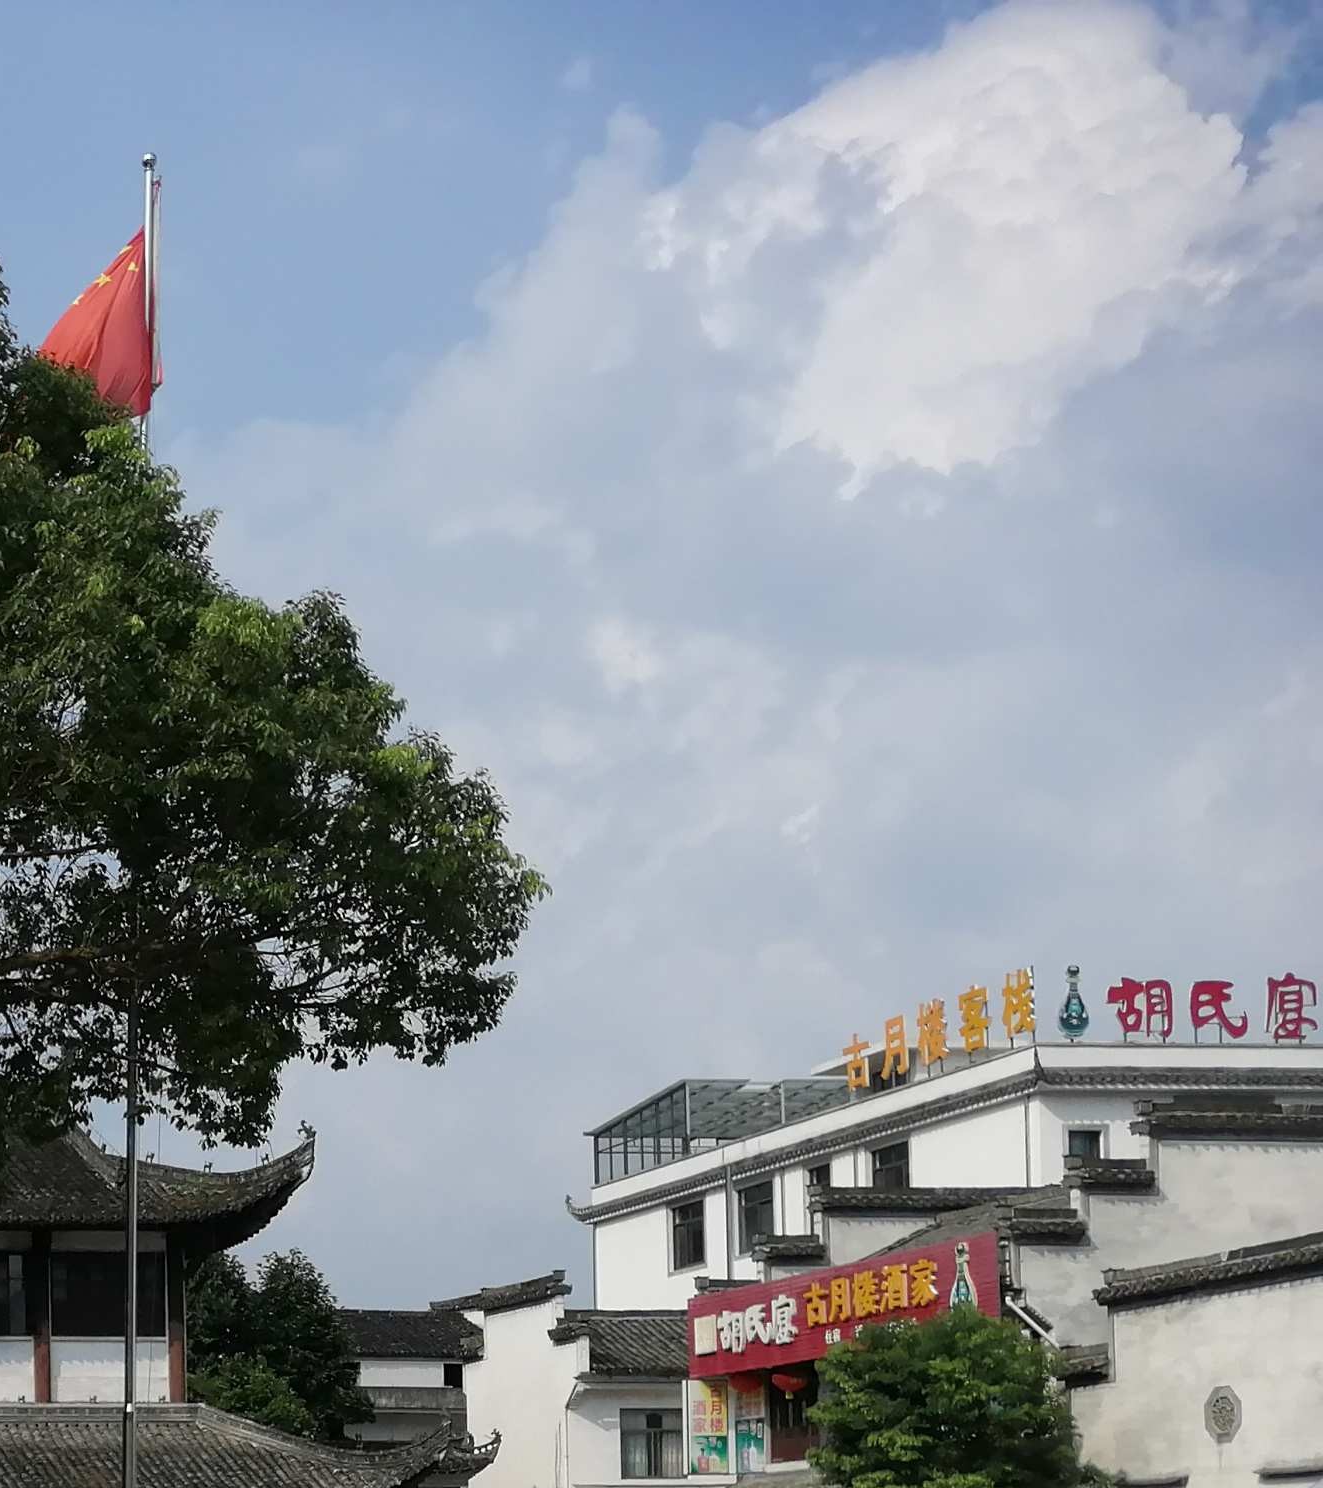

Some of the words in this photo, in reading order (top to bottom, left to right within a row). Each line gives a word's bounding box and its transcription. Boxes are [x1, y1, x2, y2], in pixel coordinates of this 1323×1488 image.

[803, 1258, 939, 1328] 古月楼酒家
